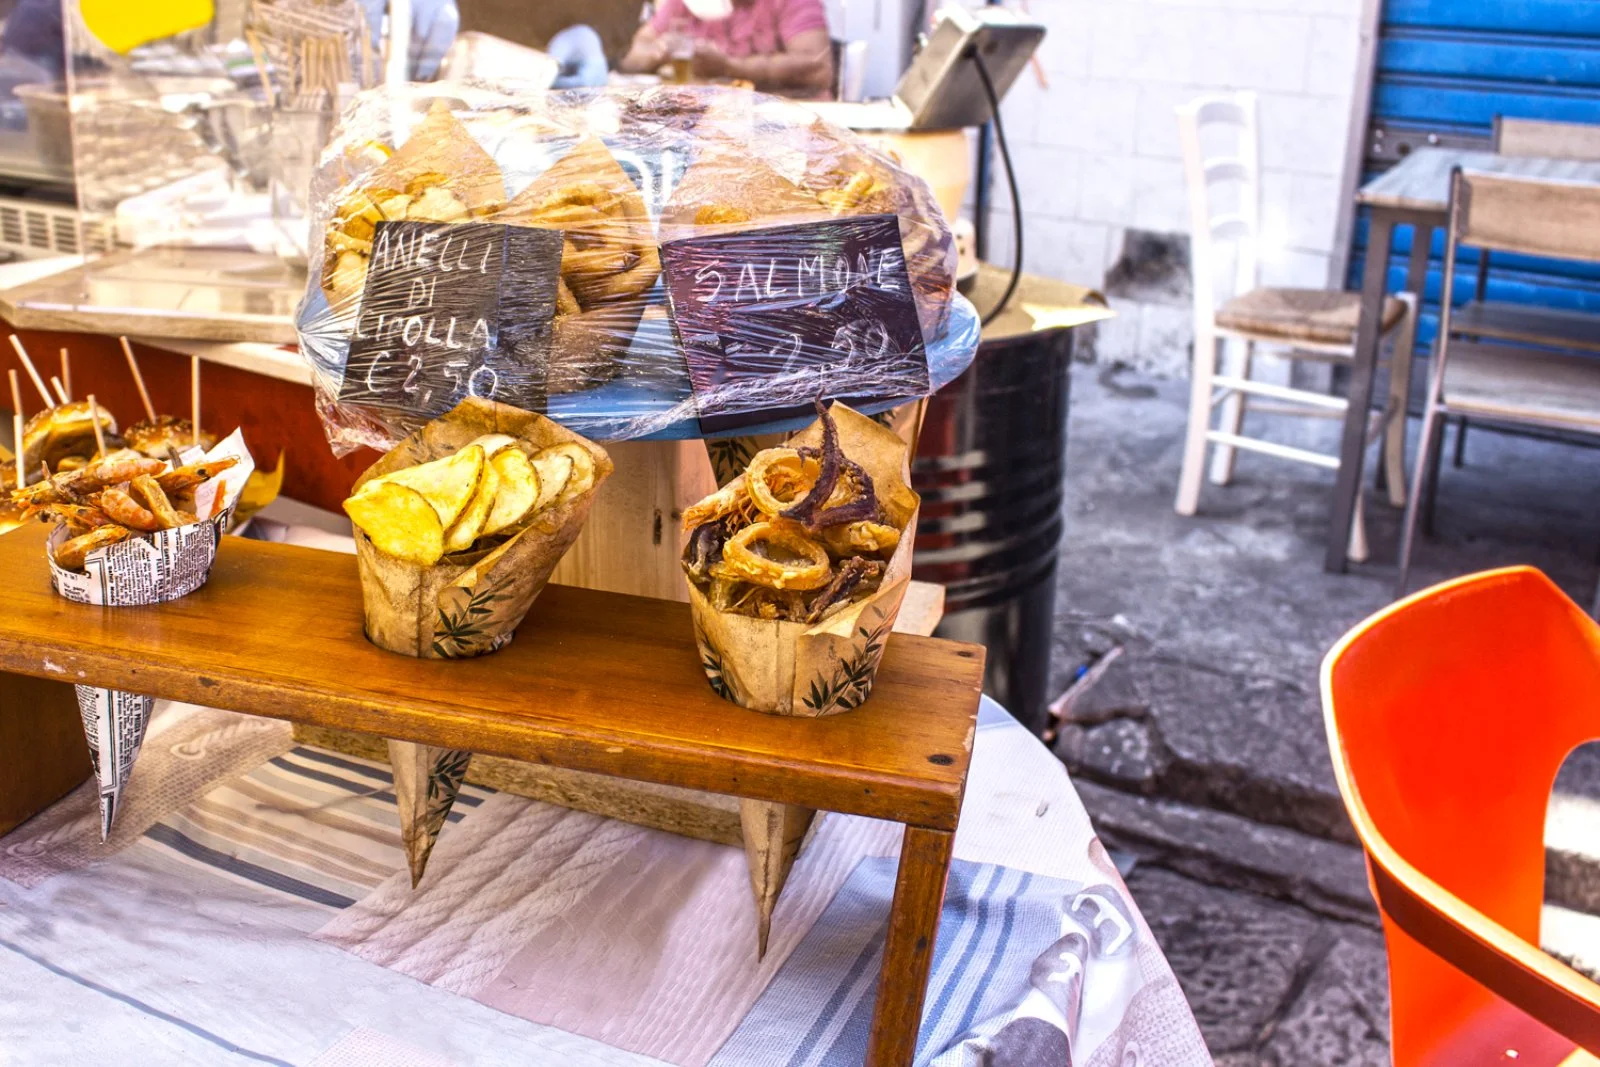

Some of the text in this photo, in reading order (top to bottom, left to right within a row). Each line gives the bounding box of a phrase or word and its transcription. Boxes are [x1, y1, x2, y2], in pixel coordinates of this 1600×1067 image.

[372, 228, 493, 274] ANELLI
[407, 275, 437, 309] DI
[694, 247, 901, 303] SALMONE
